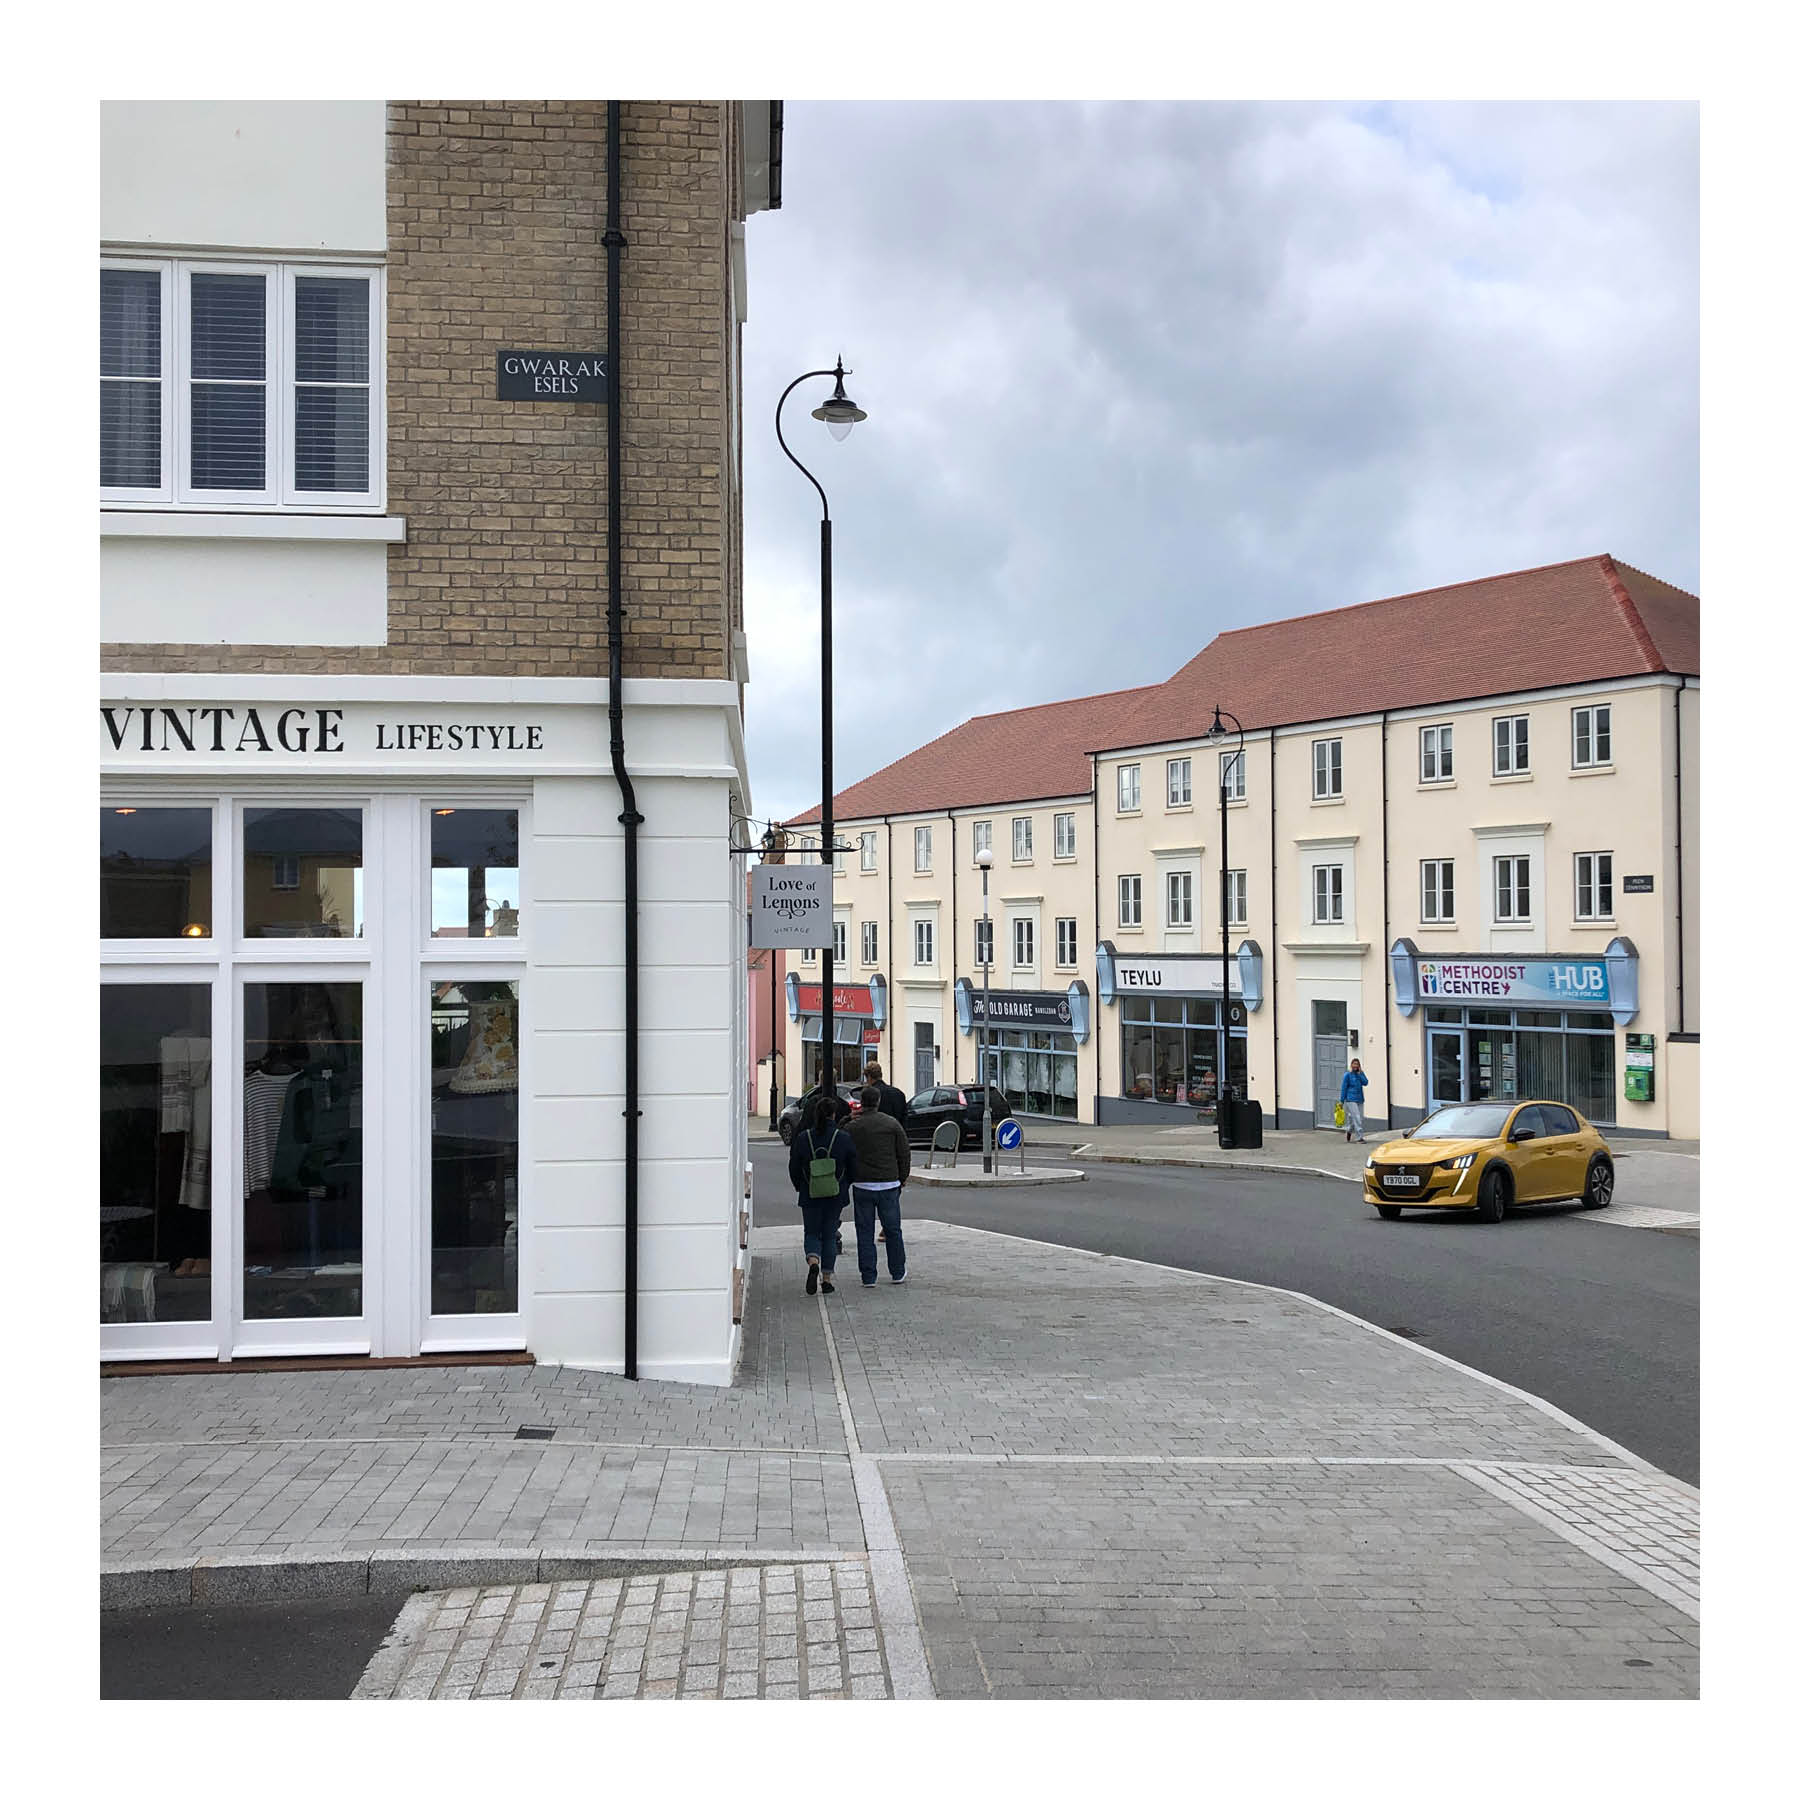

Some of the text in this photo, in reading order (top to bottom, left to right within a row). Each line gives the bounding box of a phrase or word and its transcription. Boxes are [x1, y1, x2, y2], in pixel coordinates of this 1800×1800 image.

[504, 358, 606, 376] GWARAK
[534, 376, 578, 393] ESELS
[101, 707, 544, 753] VINTAGE LIFESTYLE
[769, 877, 816, 891] Love of
[762, 895, 820, 917] Lemons
[1120, 969, 1162, 986] TEYLU
[1442, 965, 1526, 980] METHODIST
[1552, 966, 1604, 990] HUB
[1443, 981, 1500, 995] CENTRE
[989, 1001, 1003, 1015] OLD
[1003, 1002, 1033, 1017] GARAGE
